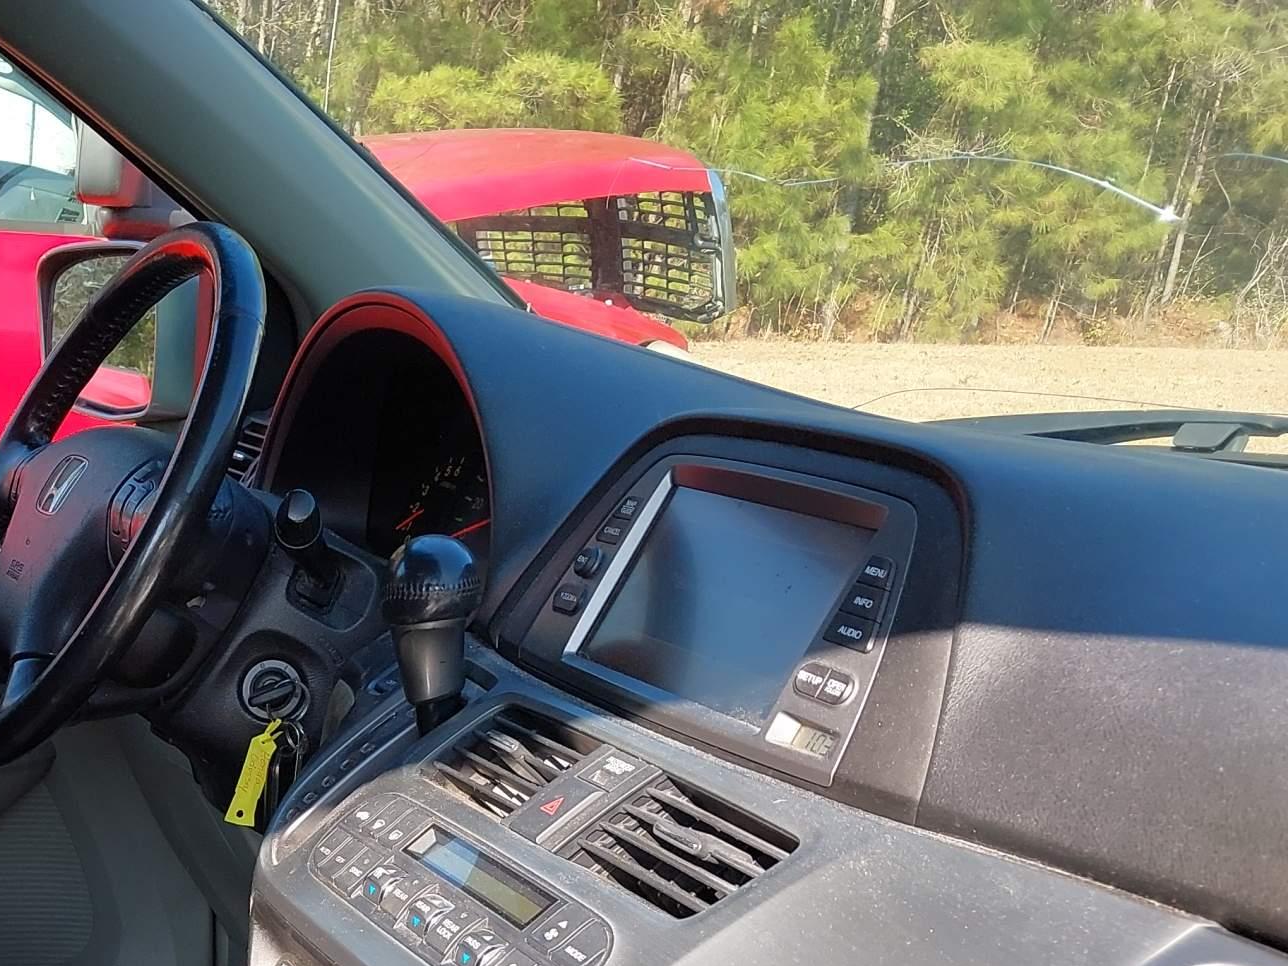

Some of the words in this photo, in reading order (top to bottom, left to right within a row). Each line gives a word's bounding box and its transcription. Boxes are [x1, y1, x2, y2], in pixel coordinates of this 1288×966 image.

[864, 565, 888, 579] MENU
[853, 596, 873, 609] INFO
[837, 625, 863, 641] AUDIO
[797, 669, 823, 686] SETUP
[392, 887, 409, 901] REAR
[435, 925, 452, 940] LOCK
[441, 917, 460, 933] REAR
[463, 934, 481, 949] PASS
[563, 944, 587, 962] MODE
